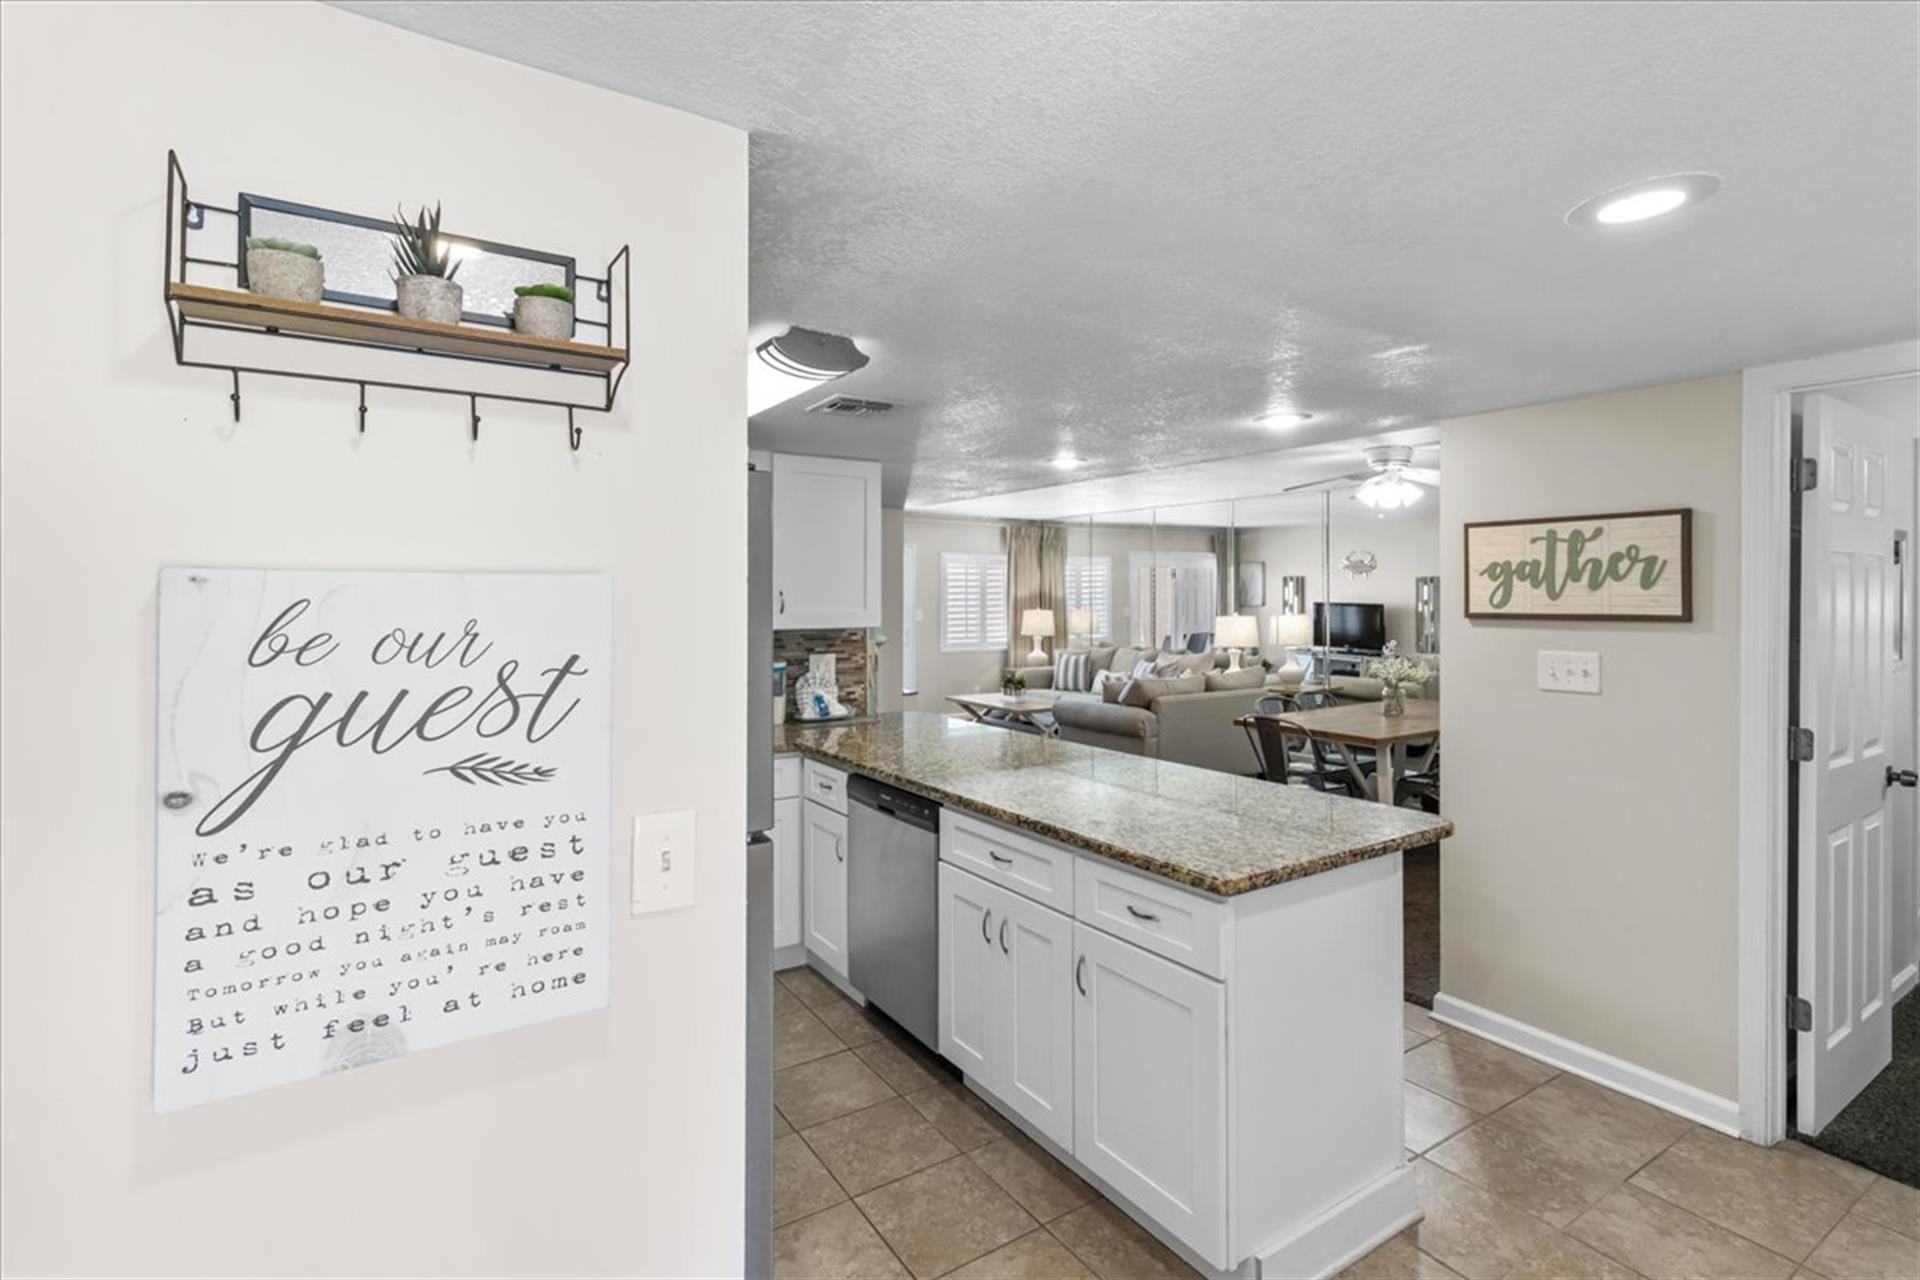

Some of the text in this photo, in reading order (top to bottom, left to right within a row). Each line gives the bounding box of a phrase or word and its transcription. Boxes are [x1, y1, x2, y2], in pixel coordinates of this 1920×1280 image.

[1479, 526, 1668, 609] gather
[248, 598, 494, 668] be our
[195, 654, 589, 837] guest
[188, 834, 584, 907] as our guest
[192, 812, 587, 867] We're glad to have you
[184, 893, 586, 973] a good night's rest
[185, 869, 585, 941] and hope you have
[187, 920, 586, 1001] Tomorrow you again may roam
[187, 1010, 245, 1035] But
[274, 988, 366, 1016] while
[526, 946, 584, 966] here
[181, 971, 587, 1074] just feel at home
